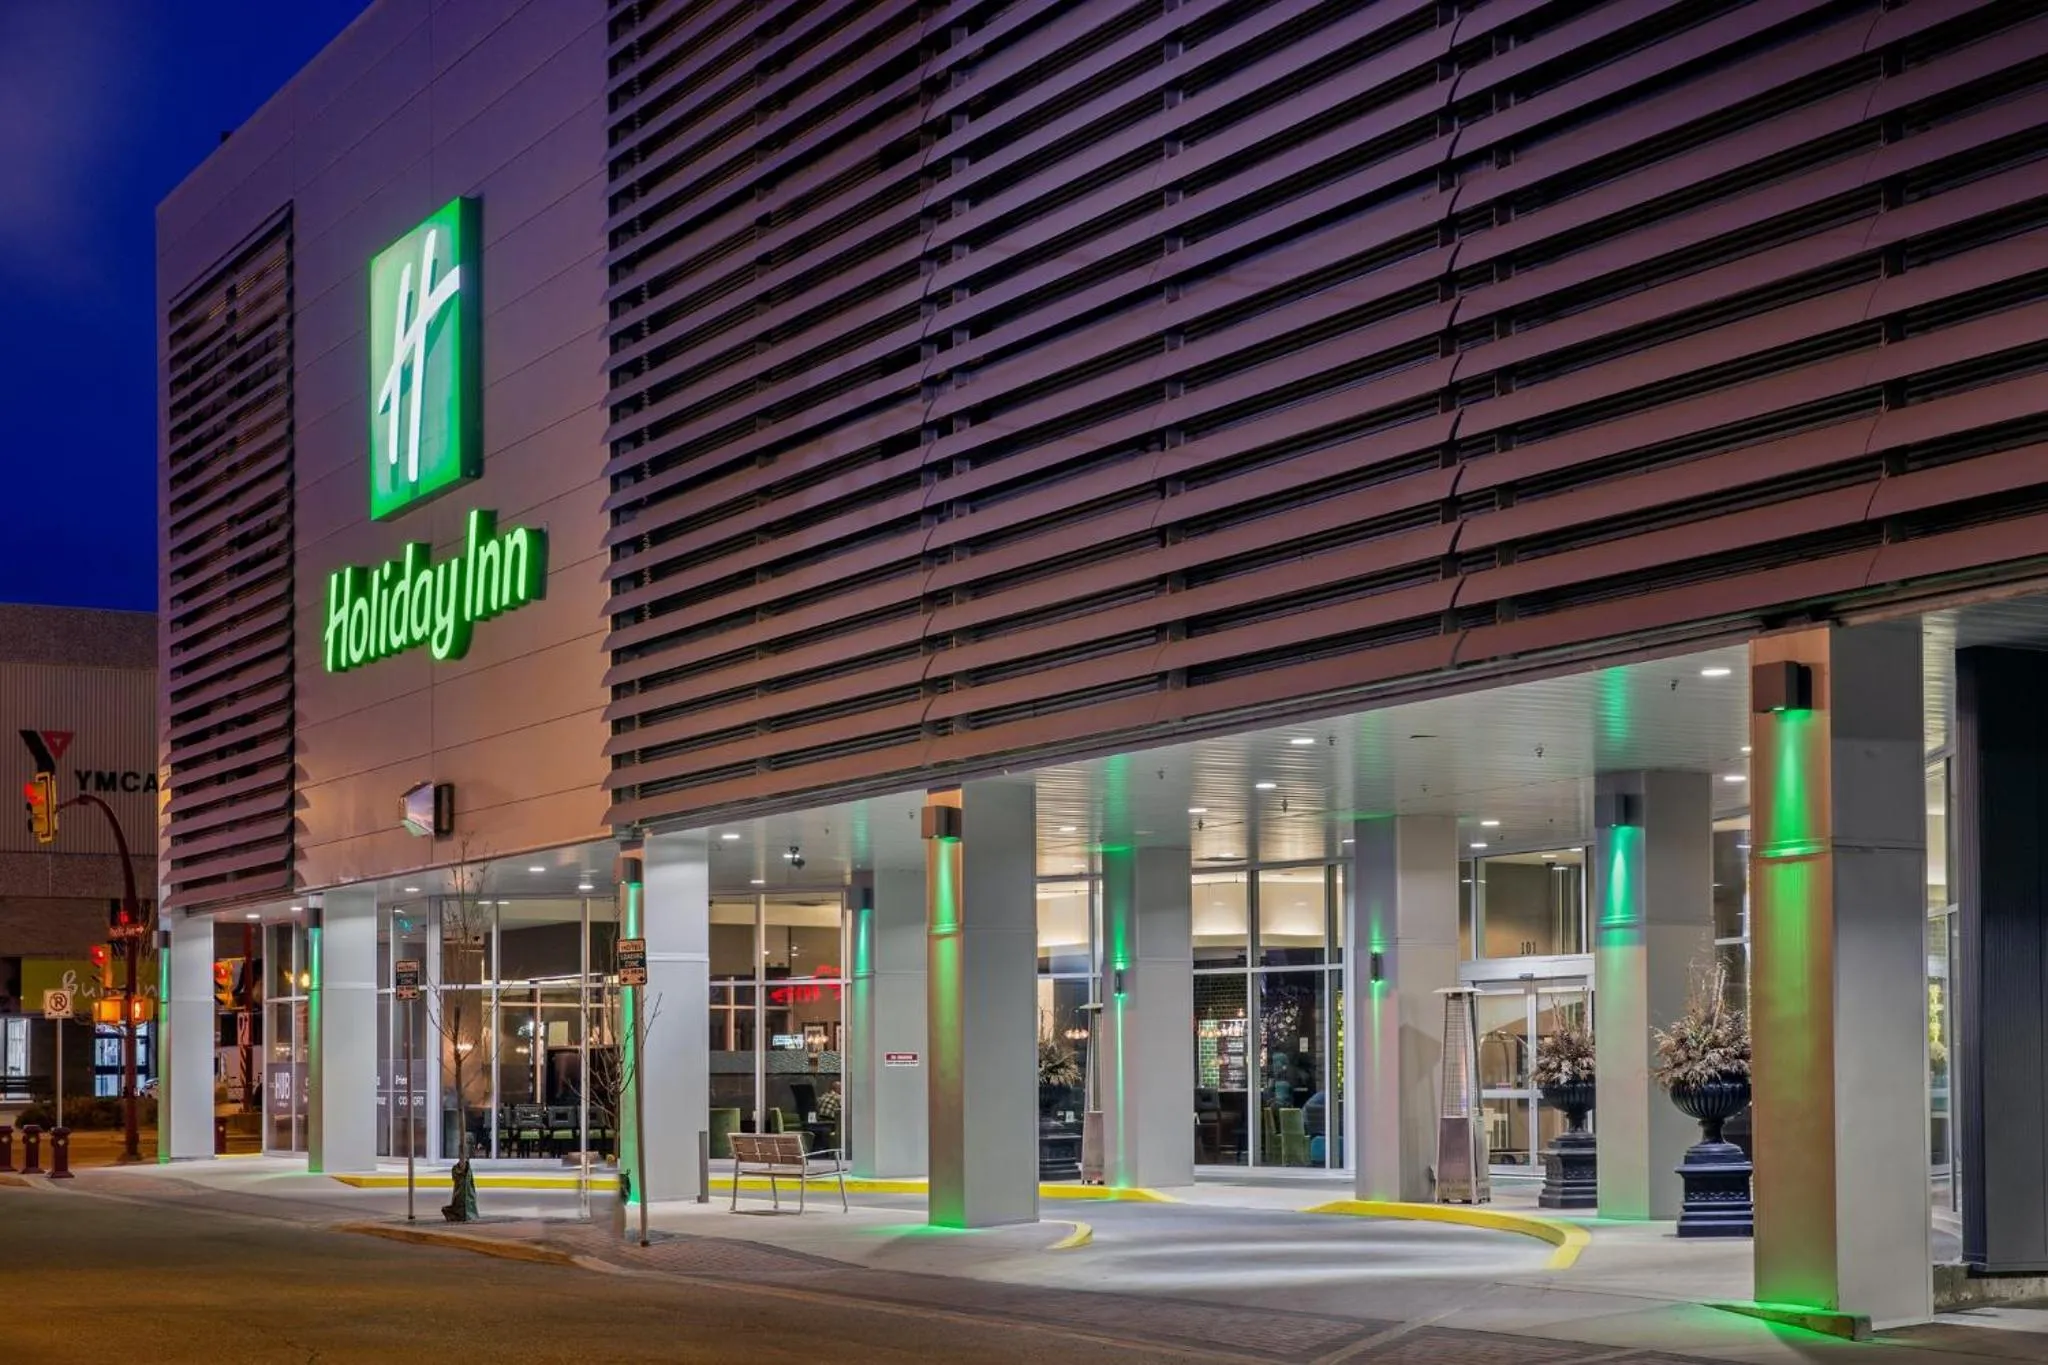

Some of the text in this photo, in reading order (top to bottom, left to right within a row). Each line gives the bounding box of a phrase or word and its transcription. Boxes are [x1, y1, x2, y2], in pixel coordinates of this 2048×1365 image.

[324, 509, 528, 673] Holiday Inn
[74, 769, 159, 793] YMCA
[1521, 941, 1537, 955] 101
[275, 1072, 290, 1100] HUB
